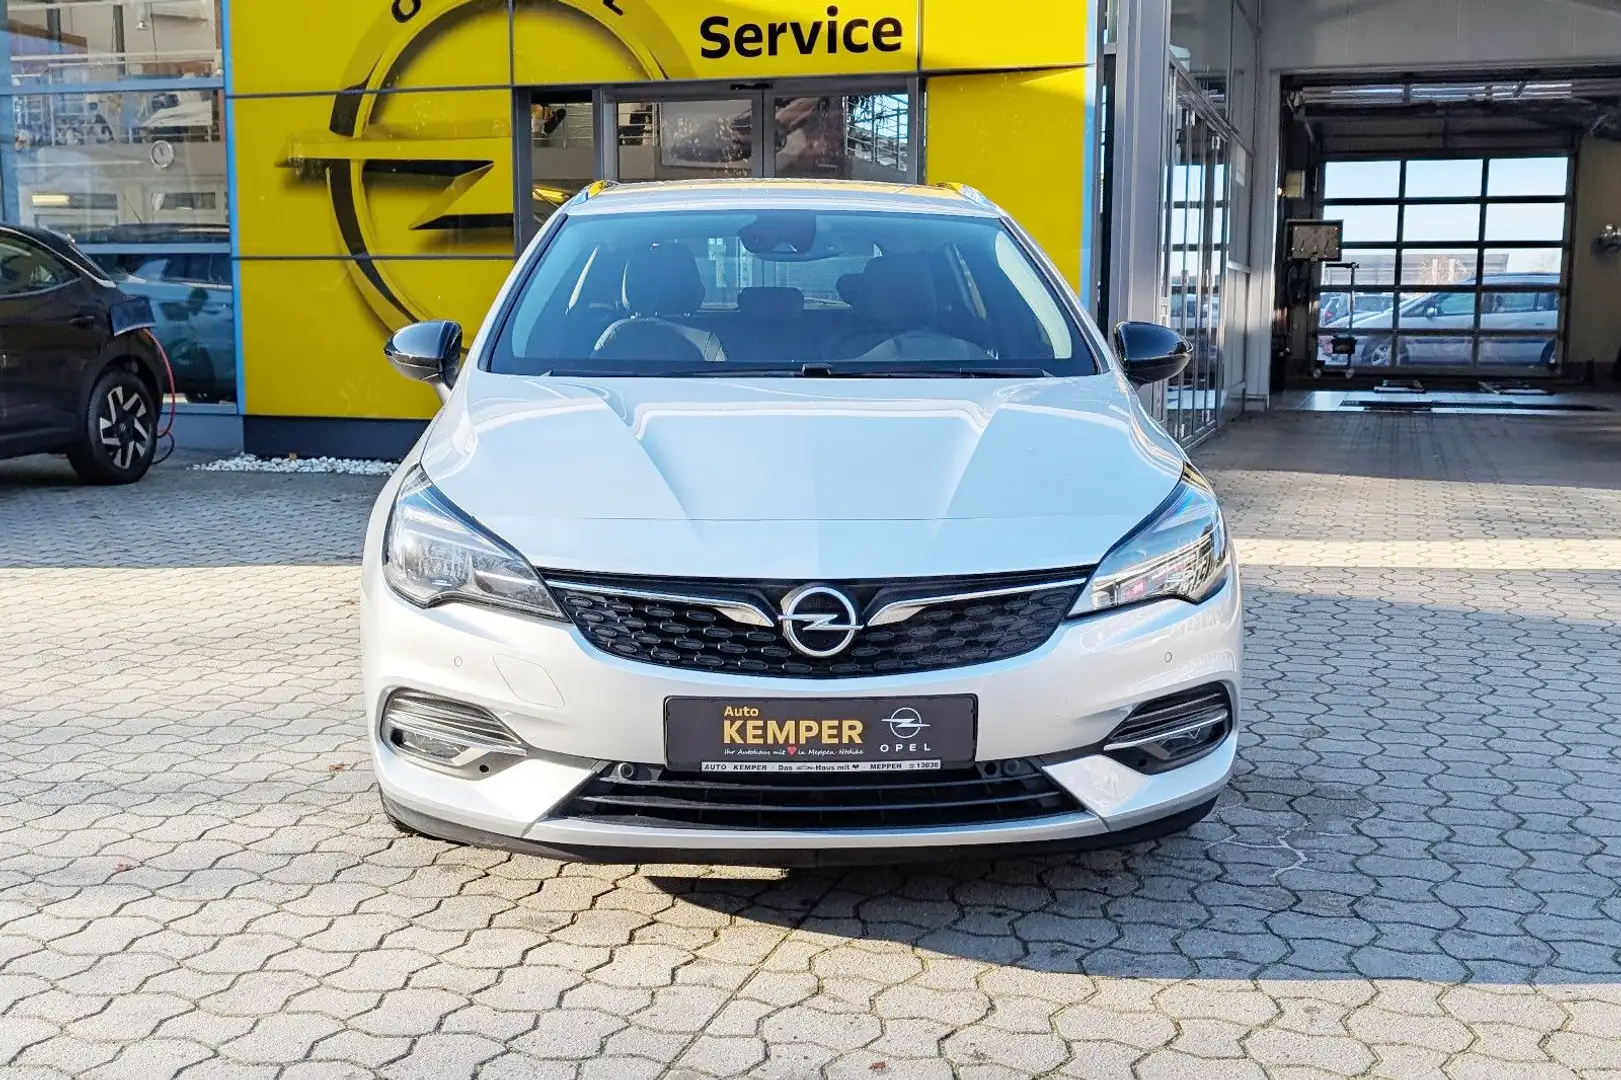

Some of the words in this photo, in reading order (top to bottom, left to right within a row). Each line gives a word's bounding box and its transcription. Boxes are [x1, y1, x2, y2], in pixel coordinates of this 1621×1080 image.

[701, 6, 903, 59] Service
[724, 706, 759, 717] Auto
[724, 720, 863, 744] KEMPER
[880, 743, 931, 752] OPEL
